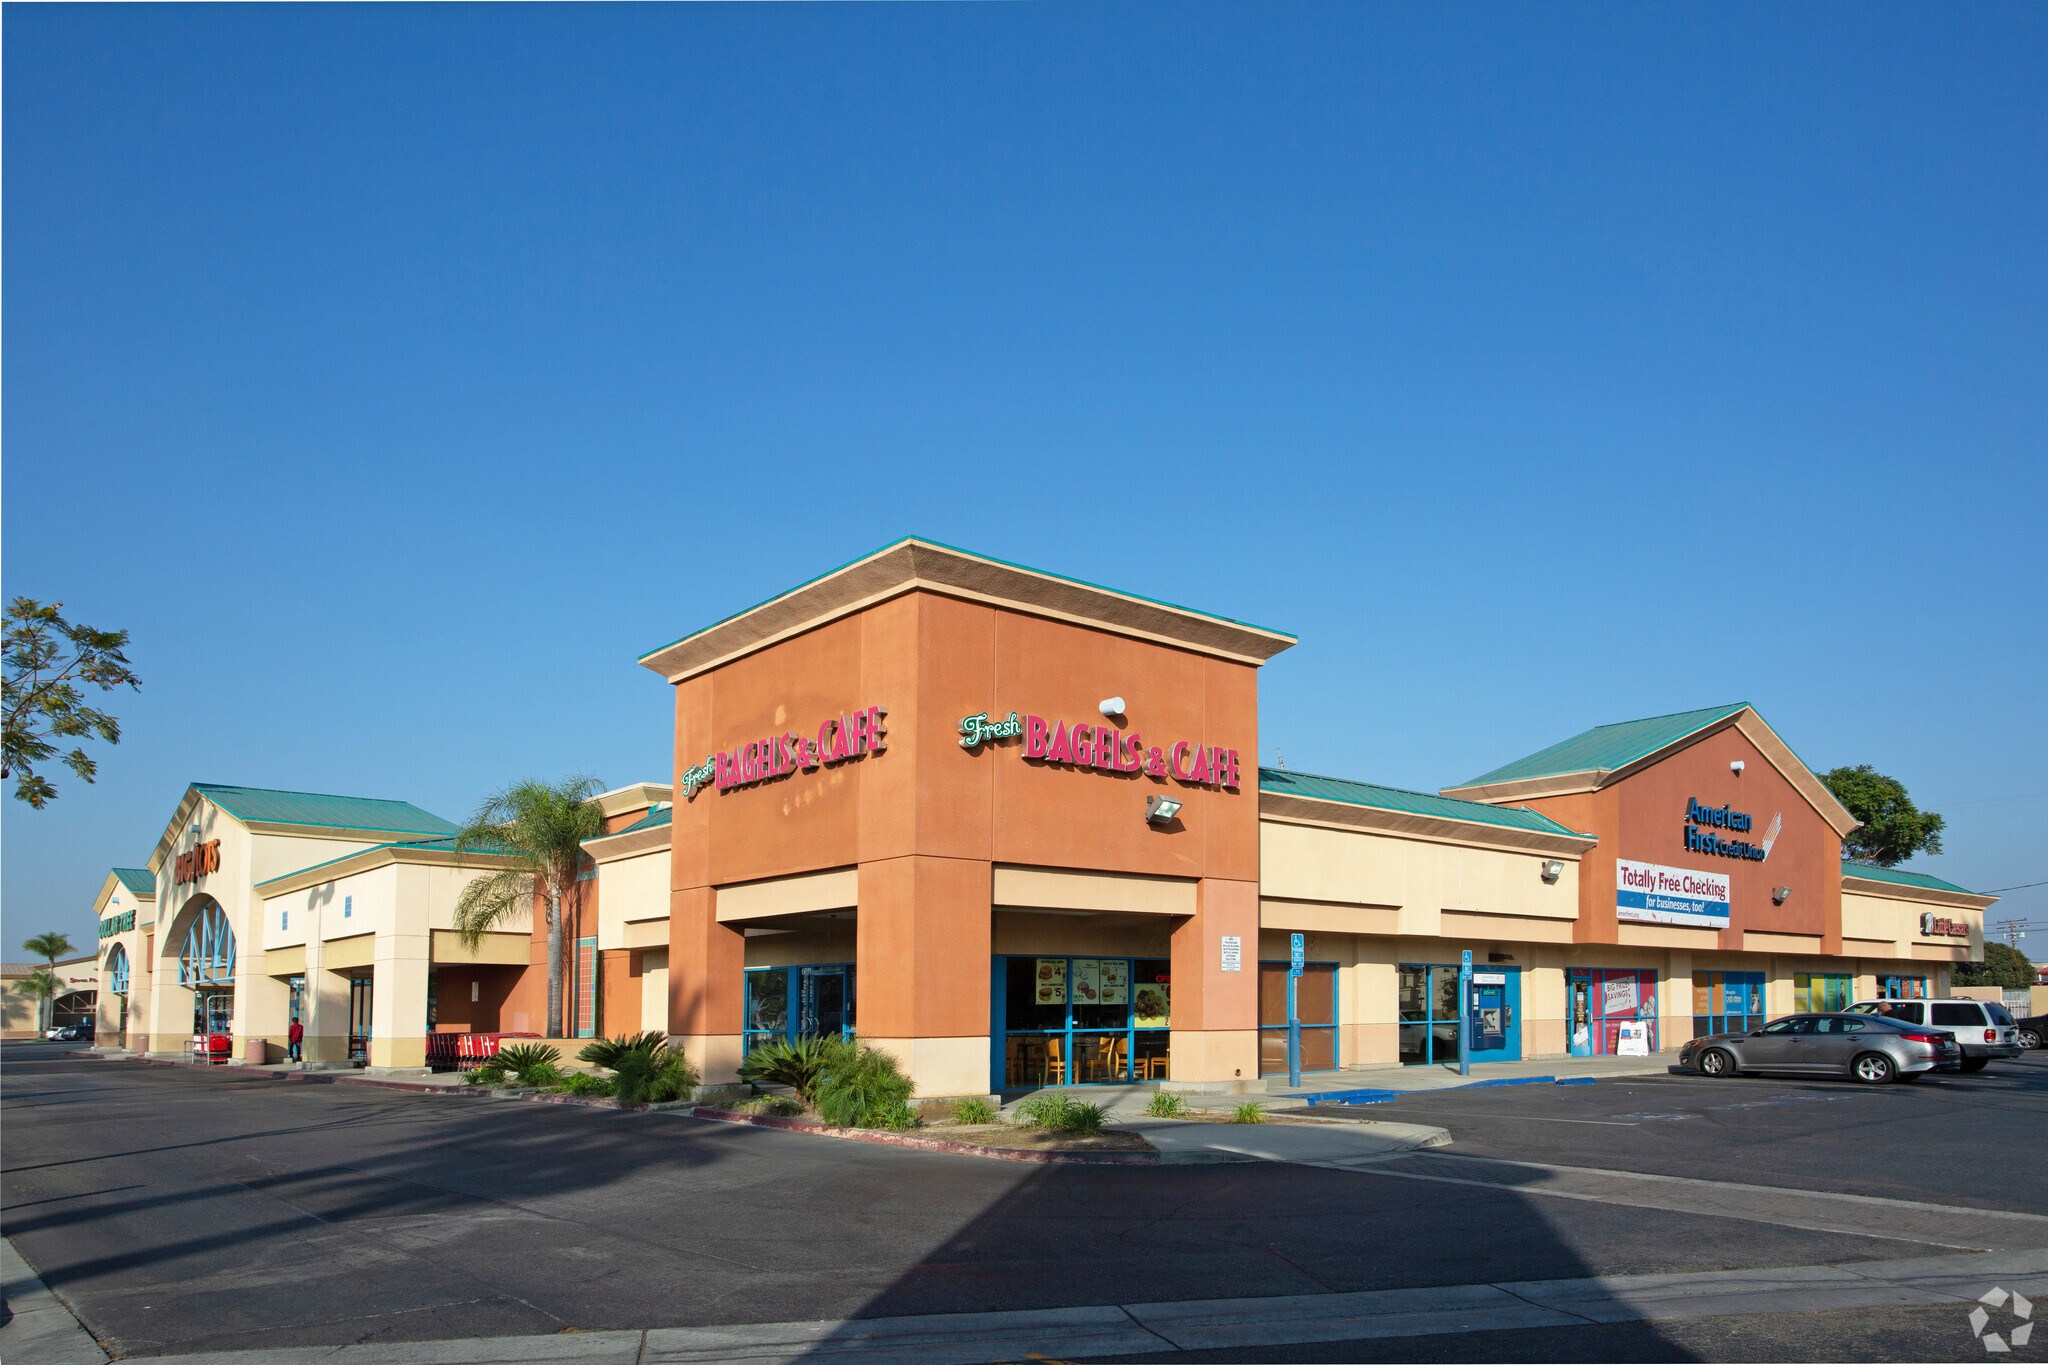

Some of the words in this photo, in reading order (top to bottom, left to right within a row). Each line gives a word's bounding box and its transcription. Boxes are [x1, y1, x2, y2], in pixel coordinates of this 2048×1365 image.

[682, 755, 714, 797] Fresh
[714, 732, 793, 791] BAGELS
[797, 737, 815, 769] &
[817, 705, 884, 763] CAFE
[963, 711, 1022, 747] Fresh
[1023, 714, 1143, 773] BAGELS
[1148, 746, 1168, 777] &
[1172, 741, 1240, 788] CAFE
[1686, 796, 1753, 831] American
[1686, 825, 1718, 854] First
[1719, 839, 1744, 857] Credit
[1744, 843, 1766, 860] Union
[174, 850, 193, 885] BIG
[1620, 866, 1656, 893] Totally
[1658, 872, 1681, 892] Free
[1682, 875, 1726, 901] Checking
[1645, 894, 1655, 910] for
[1656, 895, 1692, 911] businesses,
[1692, 901, 1705, 913] too!
[98, 915, 121, 939] DOLLAR
[120, 909, 137, 933] TREE
[1933, 917, 1948, 934] Little
[1948, 918, 1969, 936] Caesars
[1606, 983, 1616, 992] BIG
